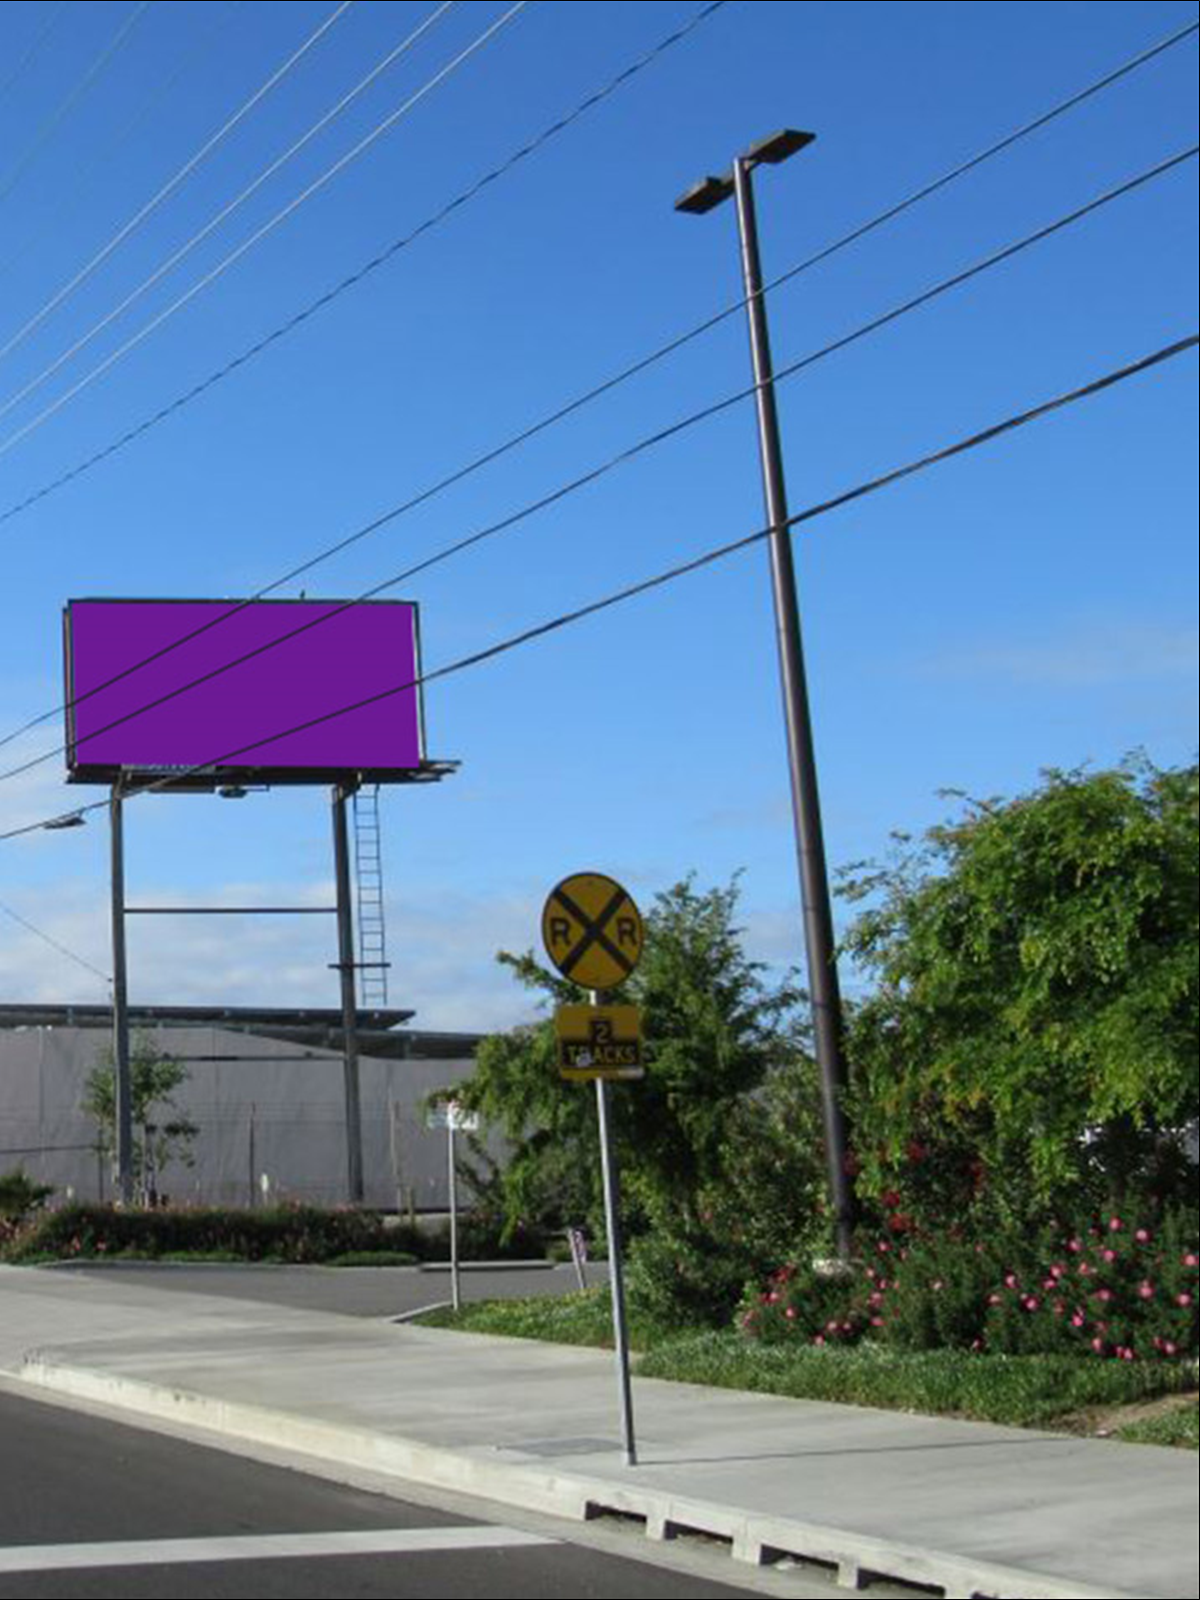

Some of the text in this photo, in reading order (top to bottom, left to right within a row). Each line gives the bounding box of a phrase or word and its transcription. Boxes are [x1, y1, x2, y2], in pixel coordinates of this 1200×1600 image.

[550, 917, 637, 946] R R
[595, 1023, 609, 1044] 2
